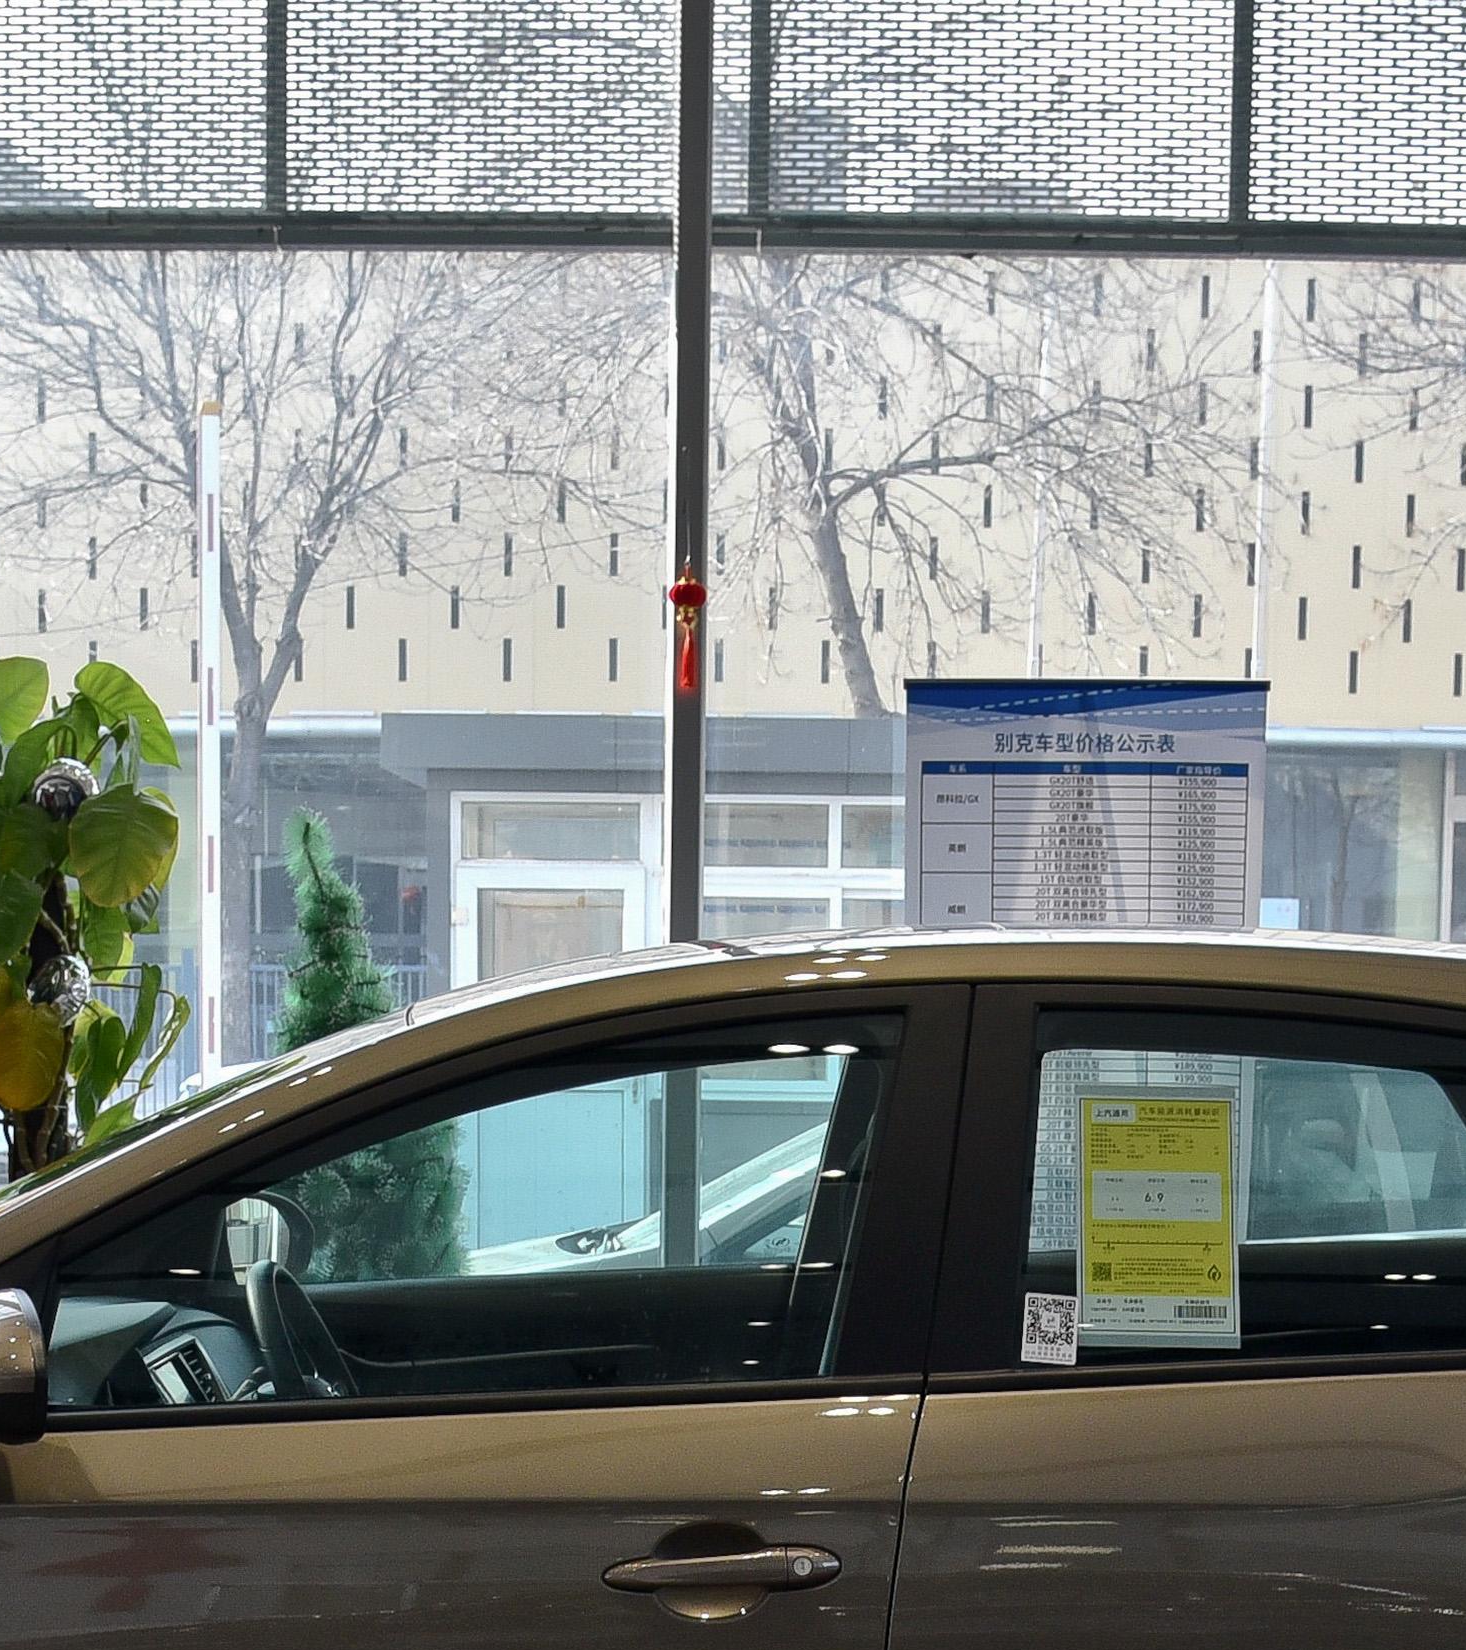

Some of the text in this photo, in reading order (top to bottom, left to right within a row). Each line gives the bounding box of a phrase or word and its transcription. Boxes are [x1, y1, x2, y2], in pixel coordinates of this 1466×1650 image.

[994, 732, 1176, 754] 别克车型价格公示表
[1144, 1192, 1165, 1203] 6.9
